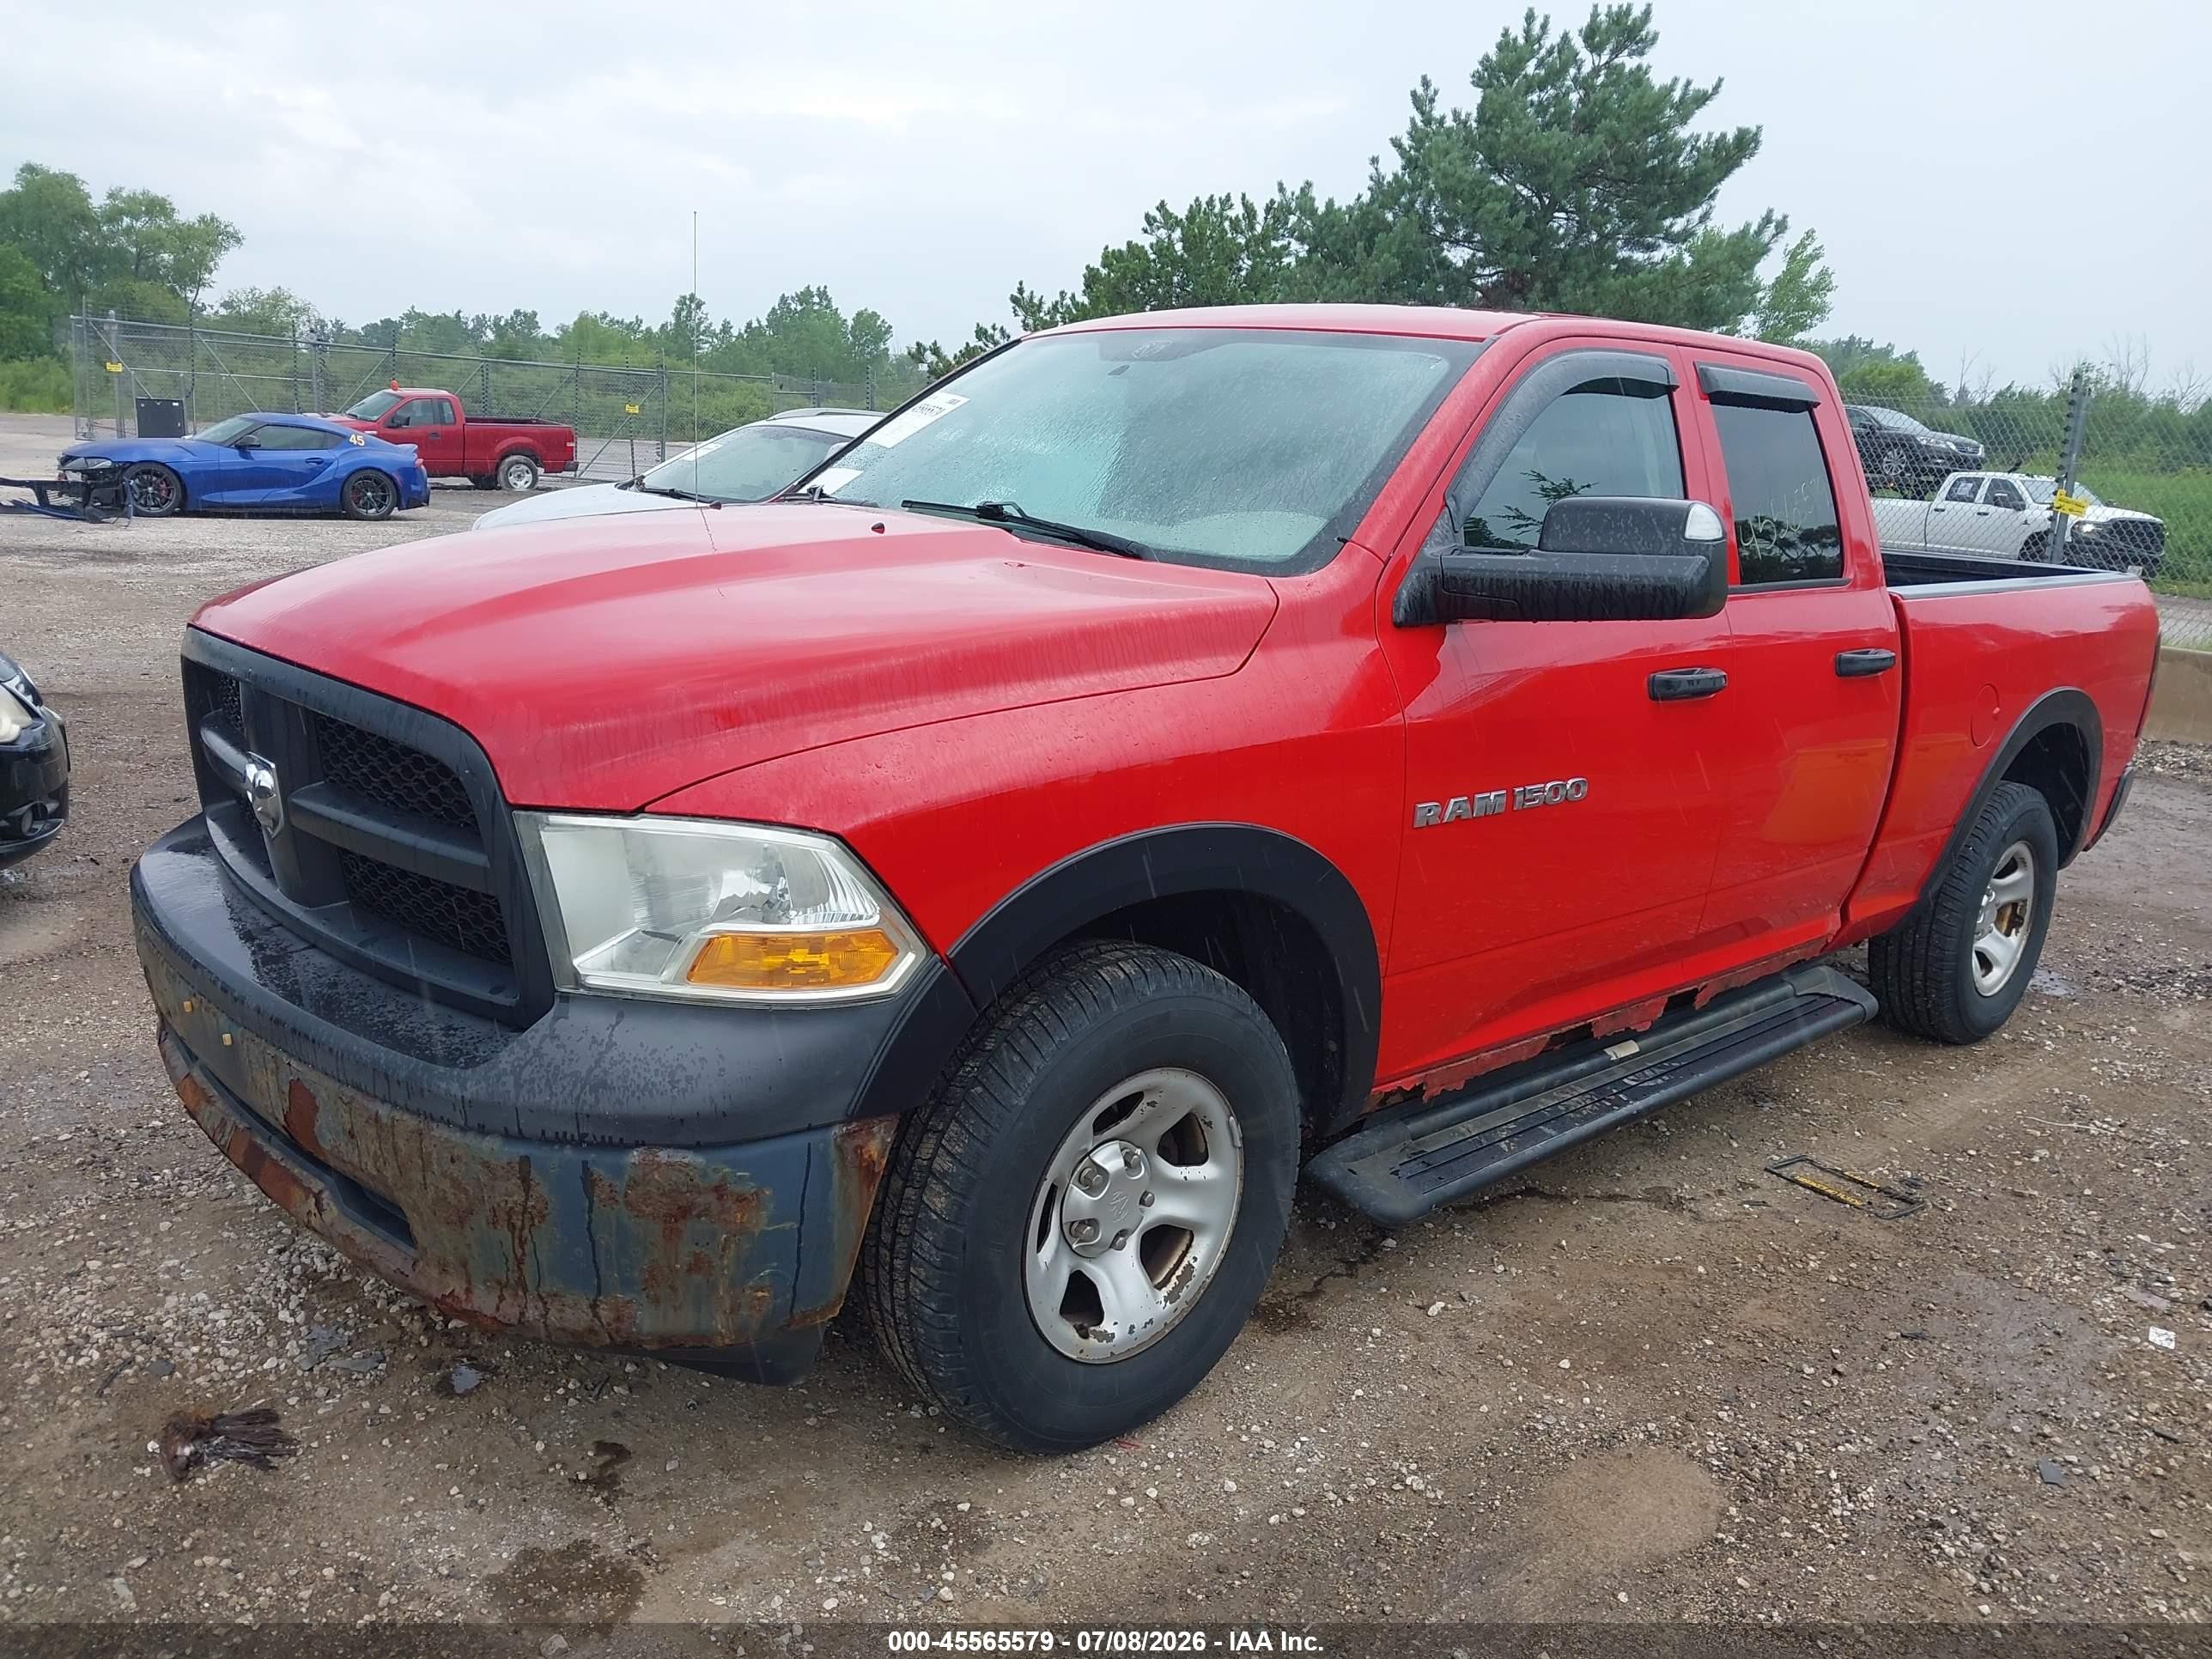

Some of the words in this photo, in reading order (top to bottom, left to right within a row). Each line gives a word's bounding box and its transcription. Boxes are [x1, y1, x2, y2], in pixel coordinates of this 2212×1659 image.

[349, 434, 365, 447] 45
[1413, 788, 1508, 828] RAM
[1513, 776, 1588, 811] 1500
